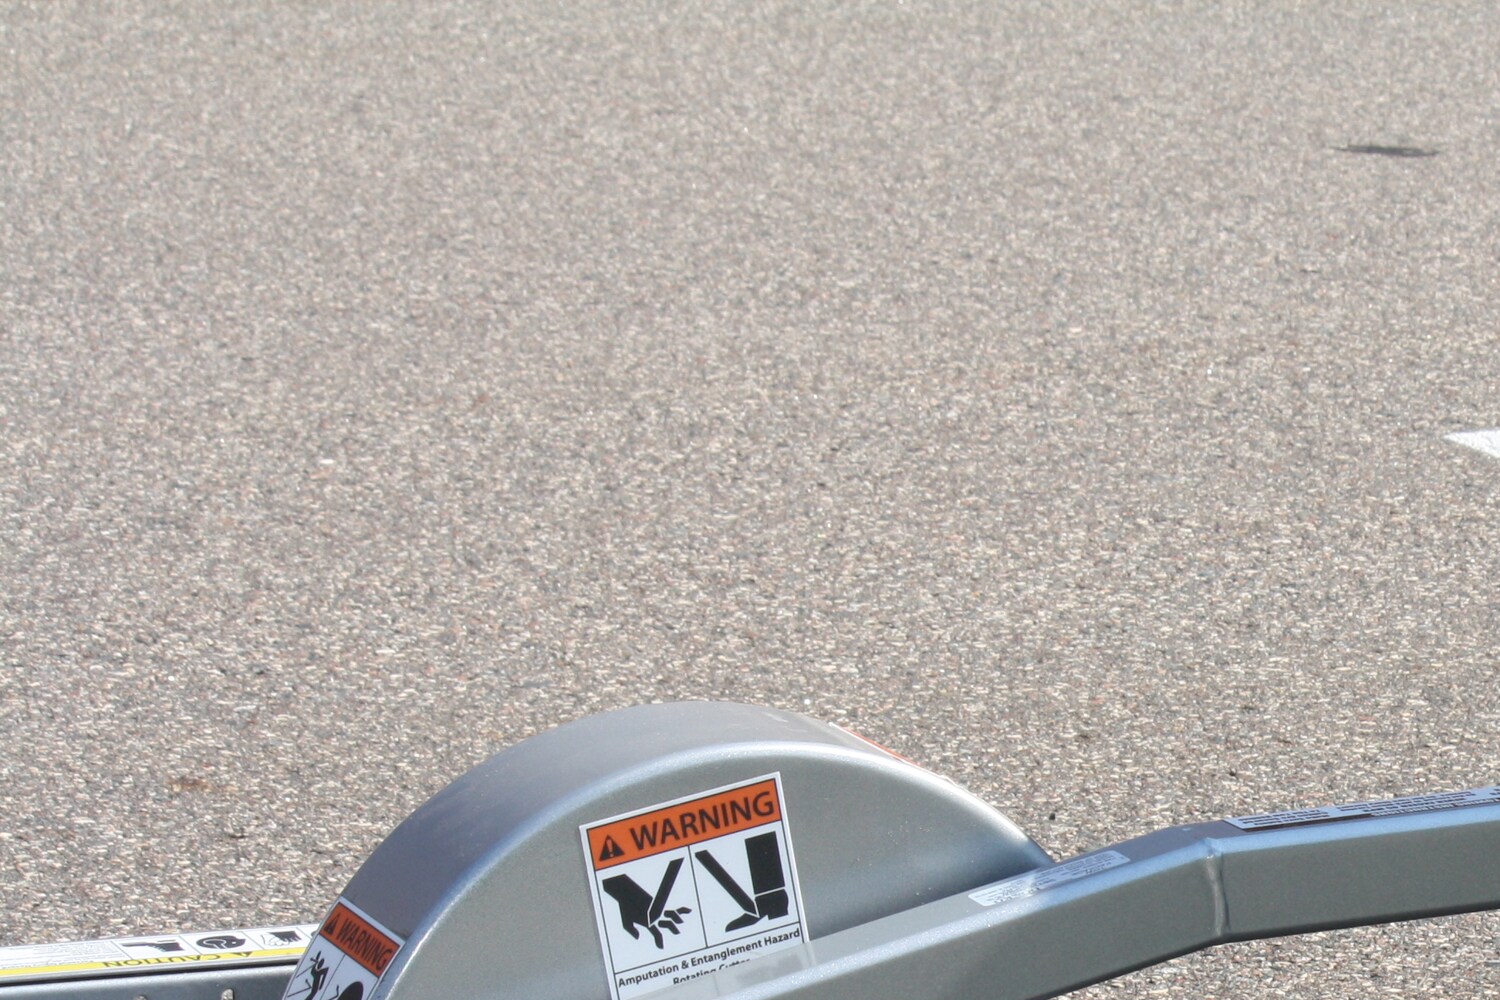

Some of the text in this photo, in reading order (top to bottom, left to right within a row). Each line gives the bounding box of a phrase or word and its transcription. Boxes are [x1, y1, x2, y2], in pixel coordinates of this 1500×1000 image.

[629, 790, 775, 851] WARNING
[102, 953, 221, 968] CAUTION
[337, 917, 394, 971] WARNING
[618, 963, 680, 988] Amputation
[681, 959, 690, 970] &
[690, 940, 763, 967] Entanglement
[764, 927, 801, 946] Hazard
